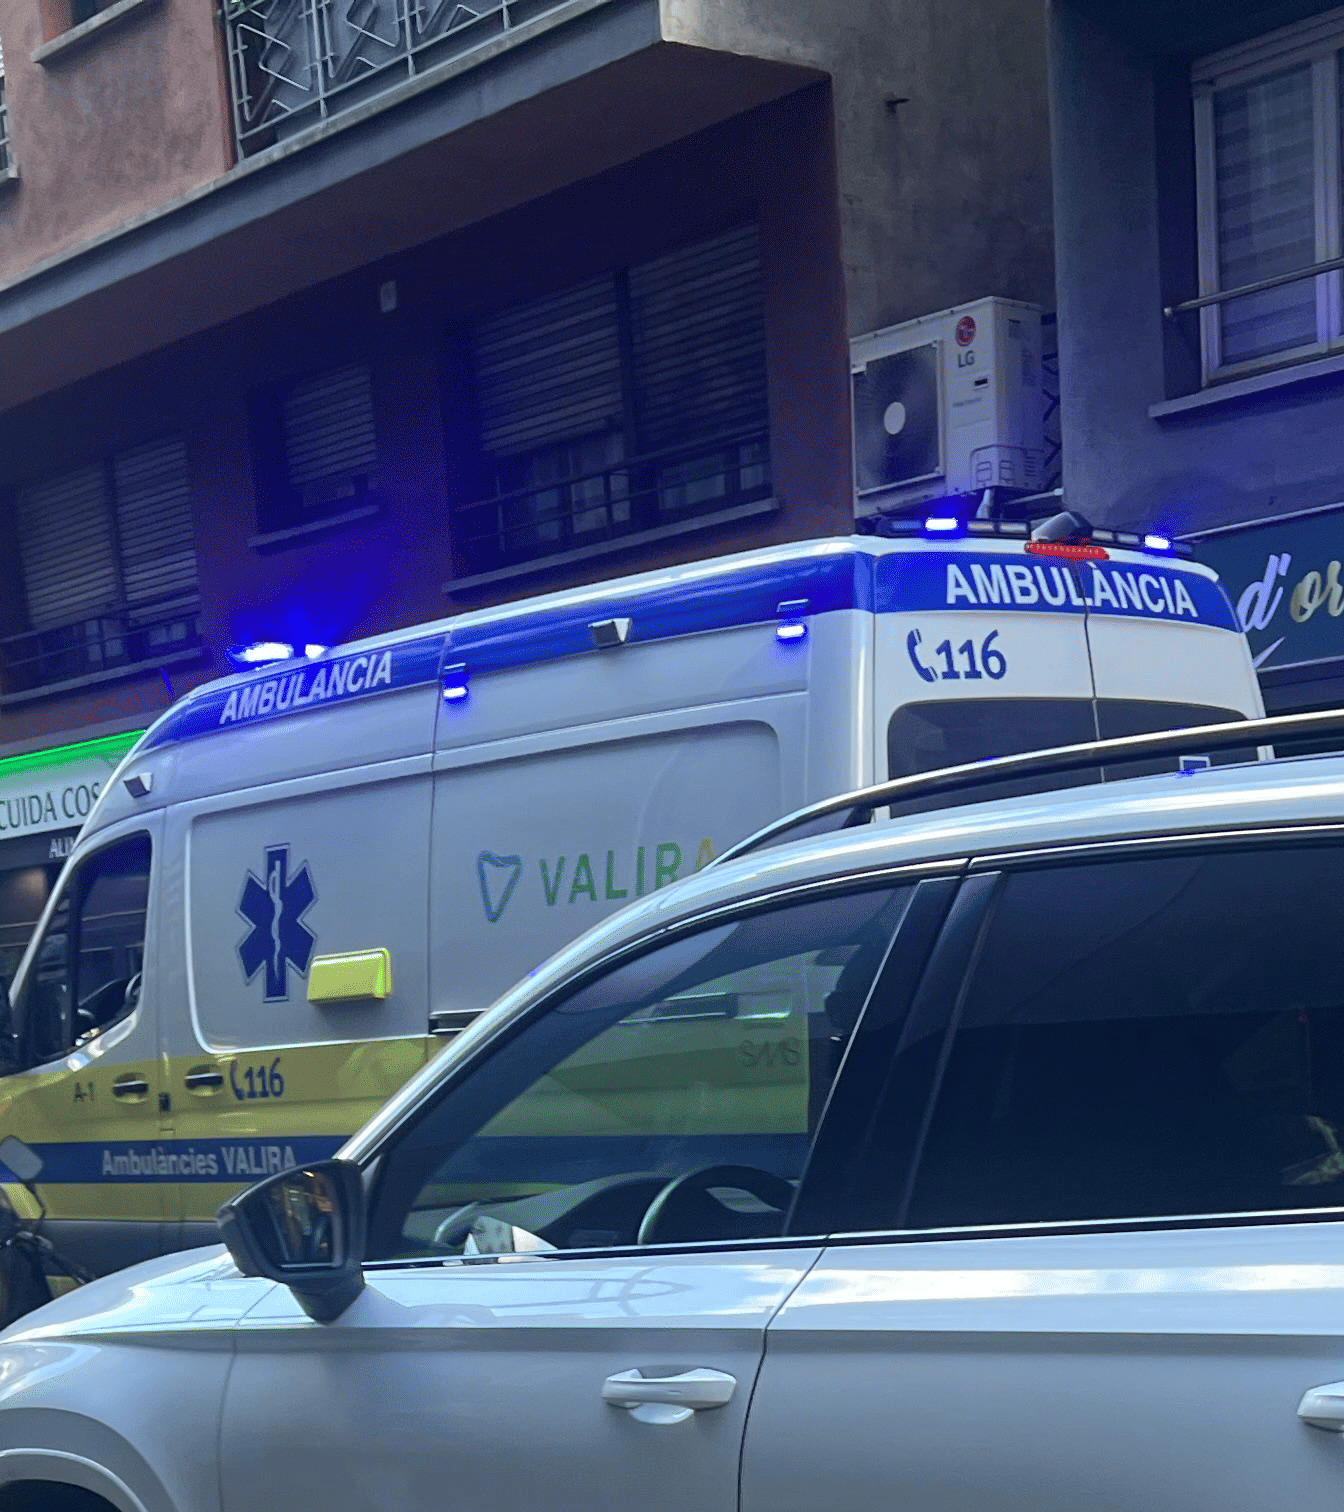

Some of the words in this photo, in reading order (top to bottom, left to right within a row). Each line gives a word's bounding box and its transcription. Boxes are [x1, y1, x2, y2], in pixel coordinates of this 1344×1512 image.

[958, 350, 975, 369] LG
[945, 561, 1199, 618] AMBULÀNCIA
[936, 629, 1008, 681] 116
[244, 1056, 286, 1099] 116
[102, 1146, 218, 1176] Ambulàncies
[221, 1145, 297, 1175] VALIRA
